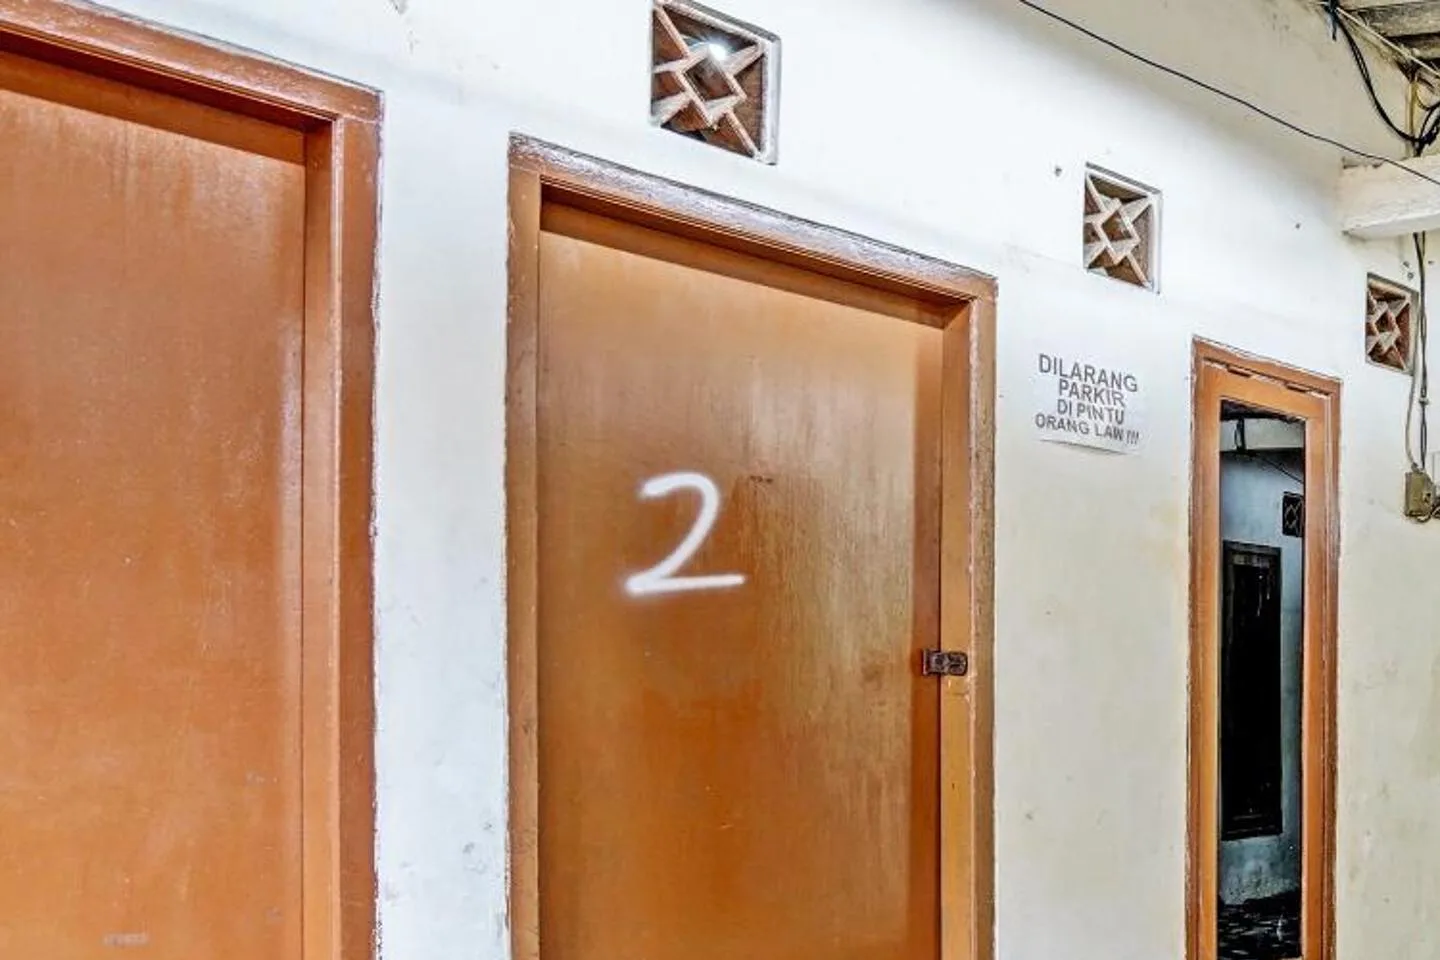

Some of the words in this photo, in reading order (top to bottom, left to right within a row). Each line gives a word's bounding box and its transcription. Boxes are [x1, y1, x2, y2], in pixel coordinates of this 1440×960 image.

[1039, 353, 1138, 392] DILARANG
[1059, 378, 1126, 408] PARKIR
[1035, 412, 1090, 435] ORANG
[1057, 398, 1072, 416] DI
[1076, 402, 1124, 425] PINTU
[626, 471, 746, 597] 2
